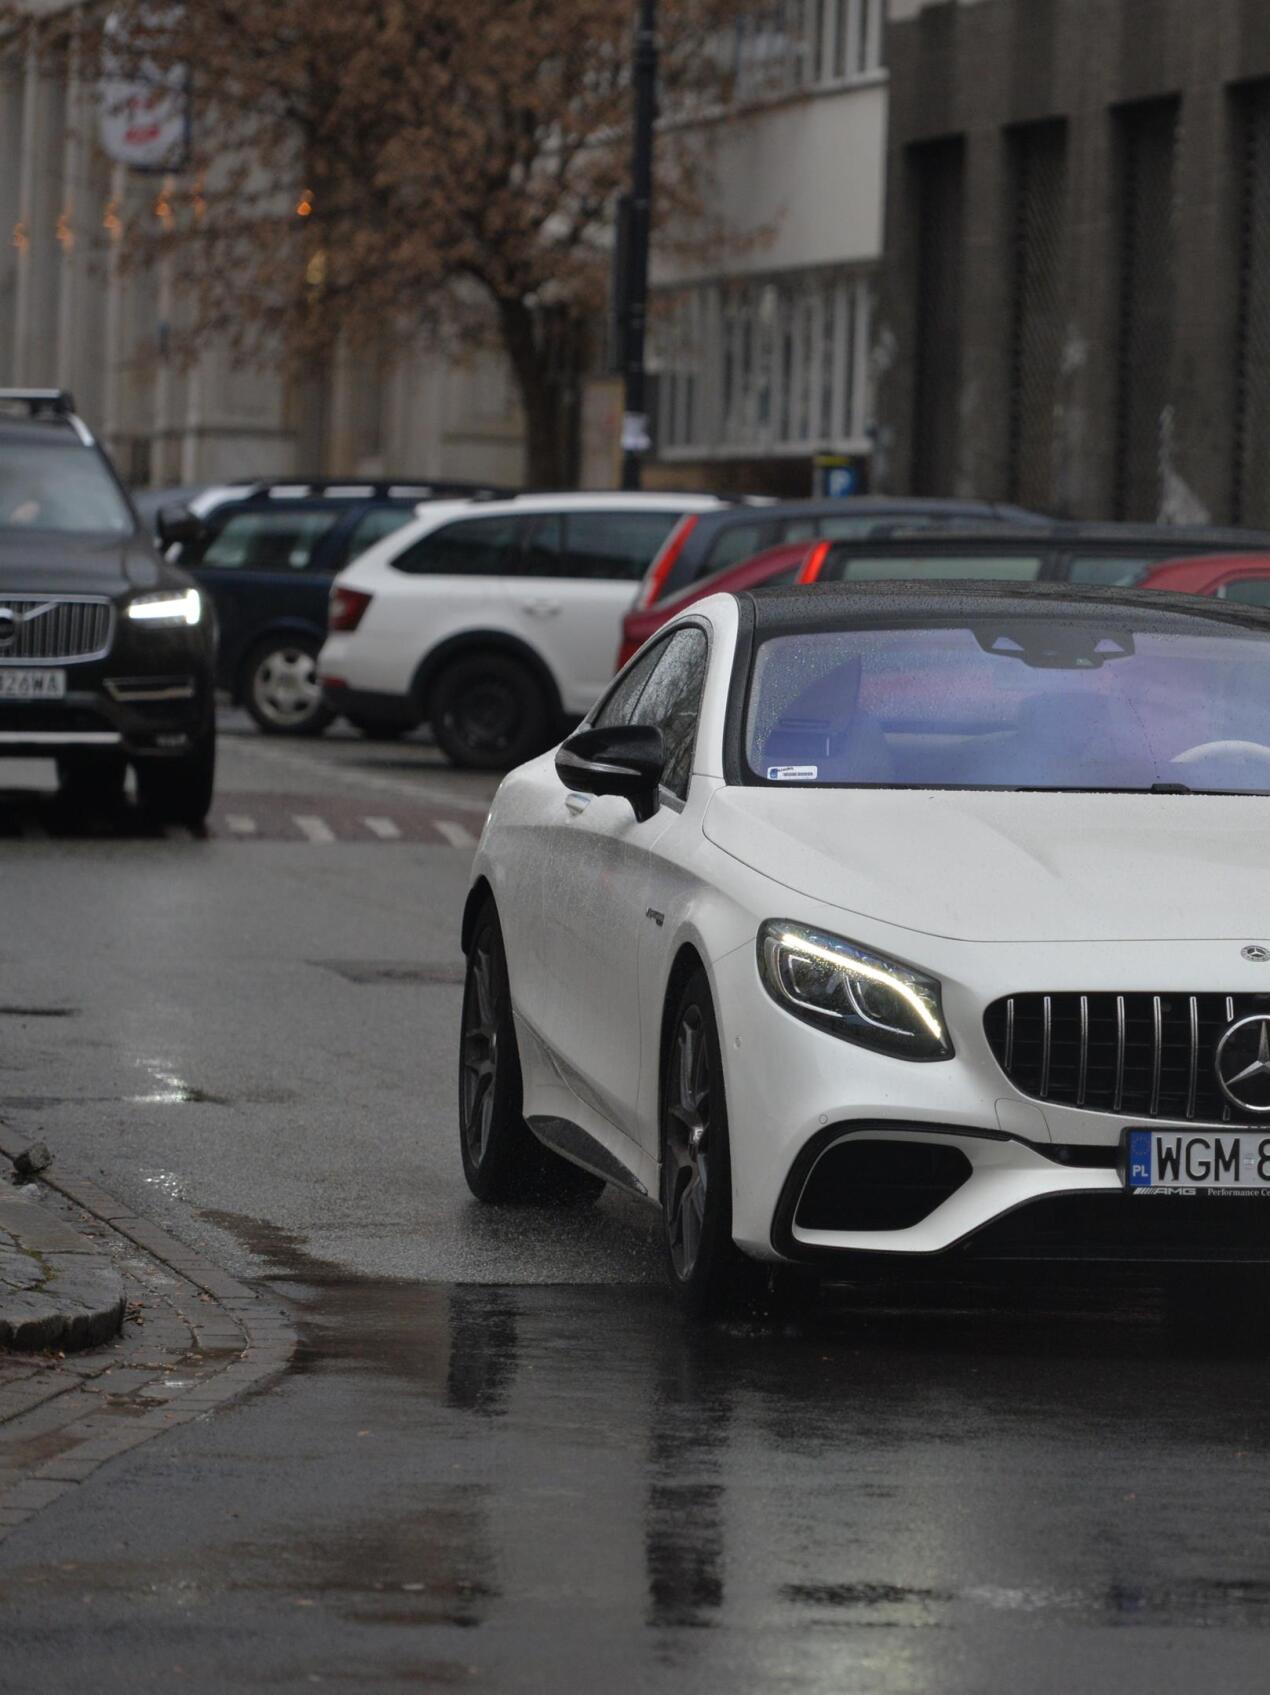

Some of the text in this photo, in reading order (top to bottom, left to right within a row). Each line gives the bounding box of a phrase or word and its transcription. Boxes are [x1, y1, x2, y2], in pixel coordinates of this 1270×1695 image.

[1157, 1137, 1240, 1181] WGM
[1132, 1165, 1148, 1177] PL
[1207, 1188, 1259, 1197] Performance
